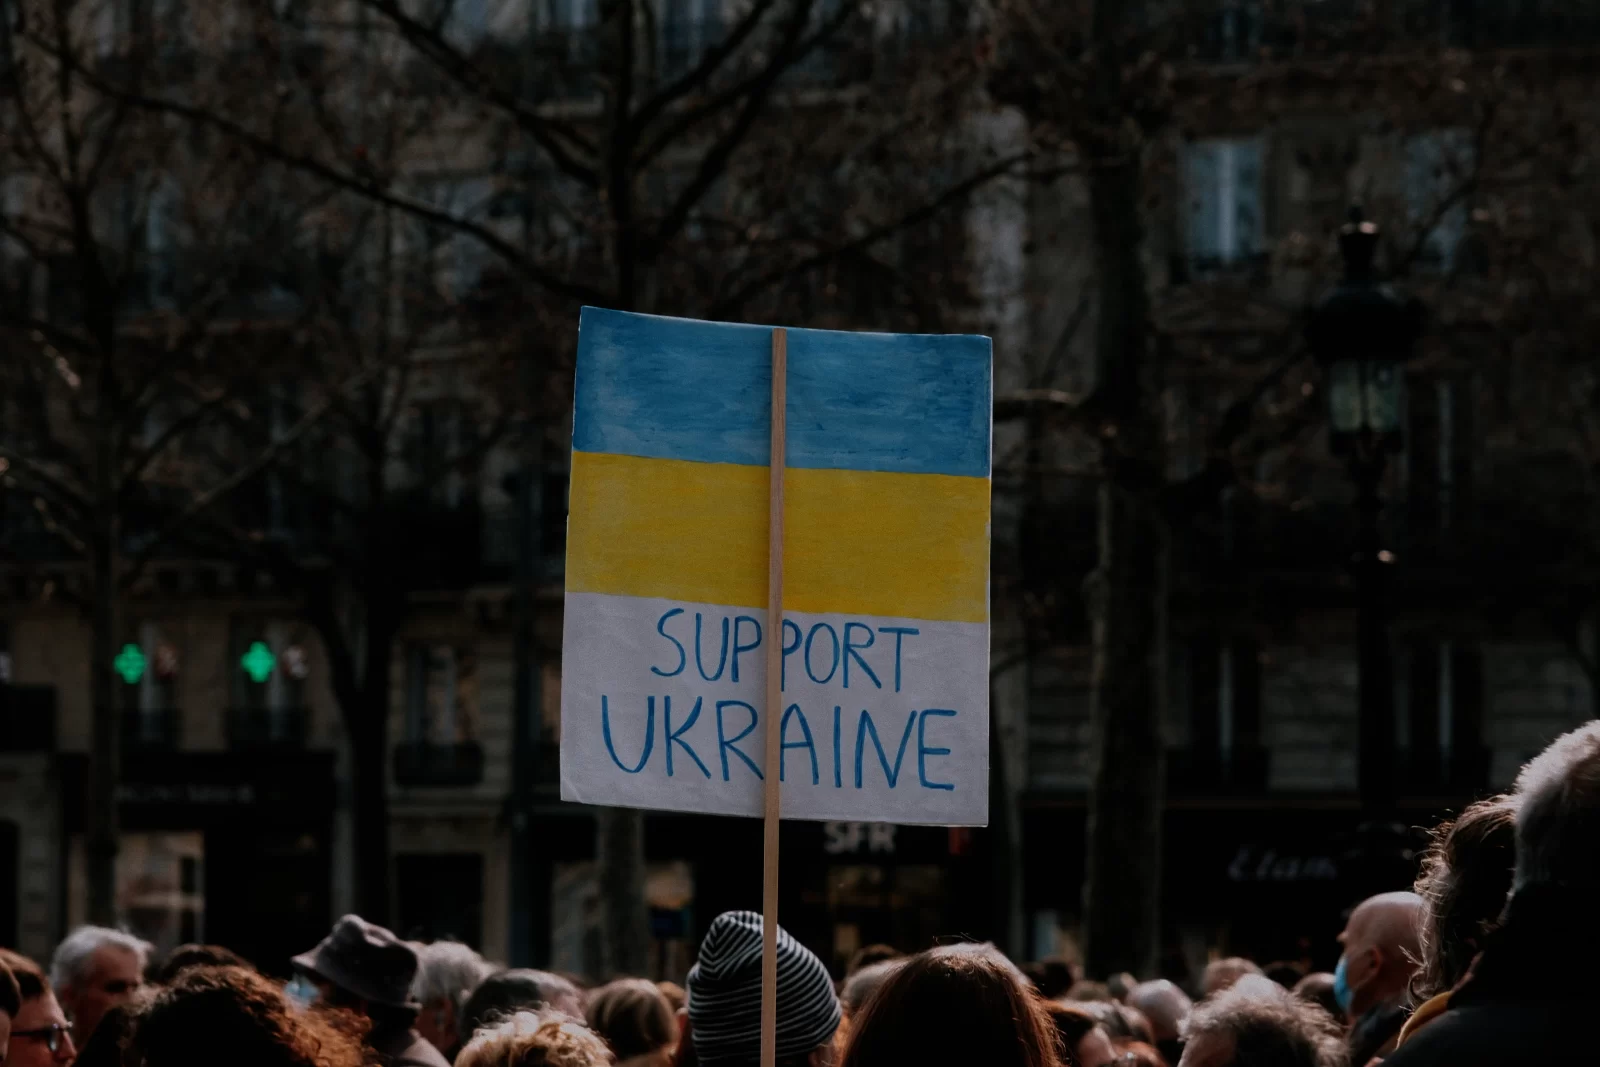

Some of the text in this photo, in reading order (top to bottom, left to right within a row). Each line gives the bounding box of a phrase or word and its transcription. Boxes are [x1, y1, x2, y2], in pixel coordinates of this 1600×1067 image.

[650, 608, 919, 693] SUPPORT
[601, 695, 957, 790] UKRAINE
[824, 822, 897, 855] SFR
